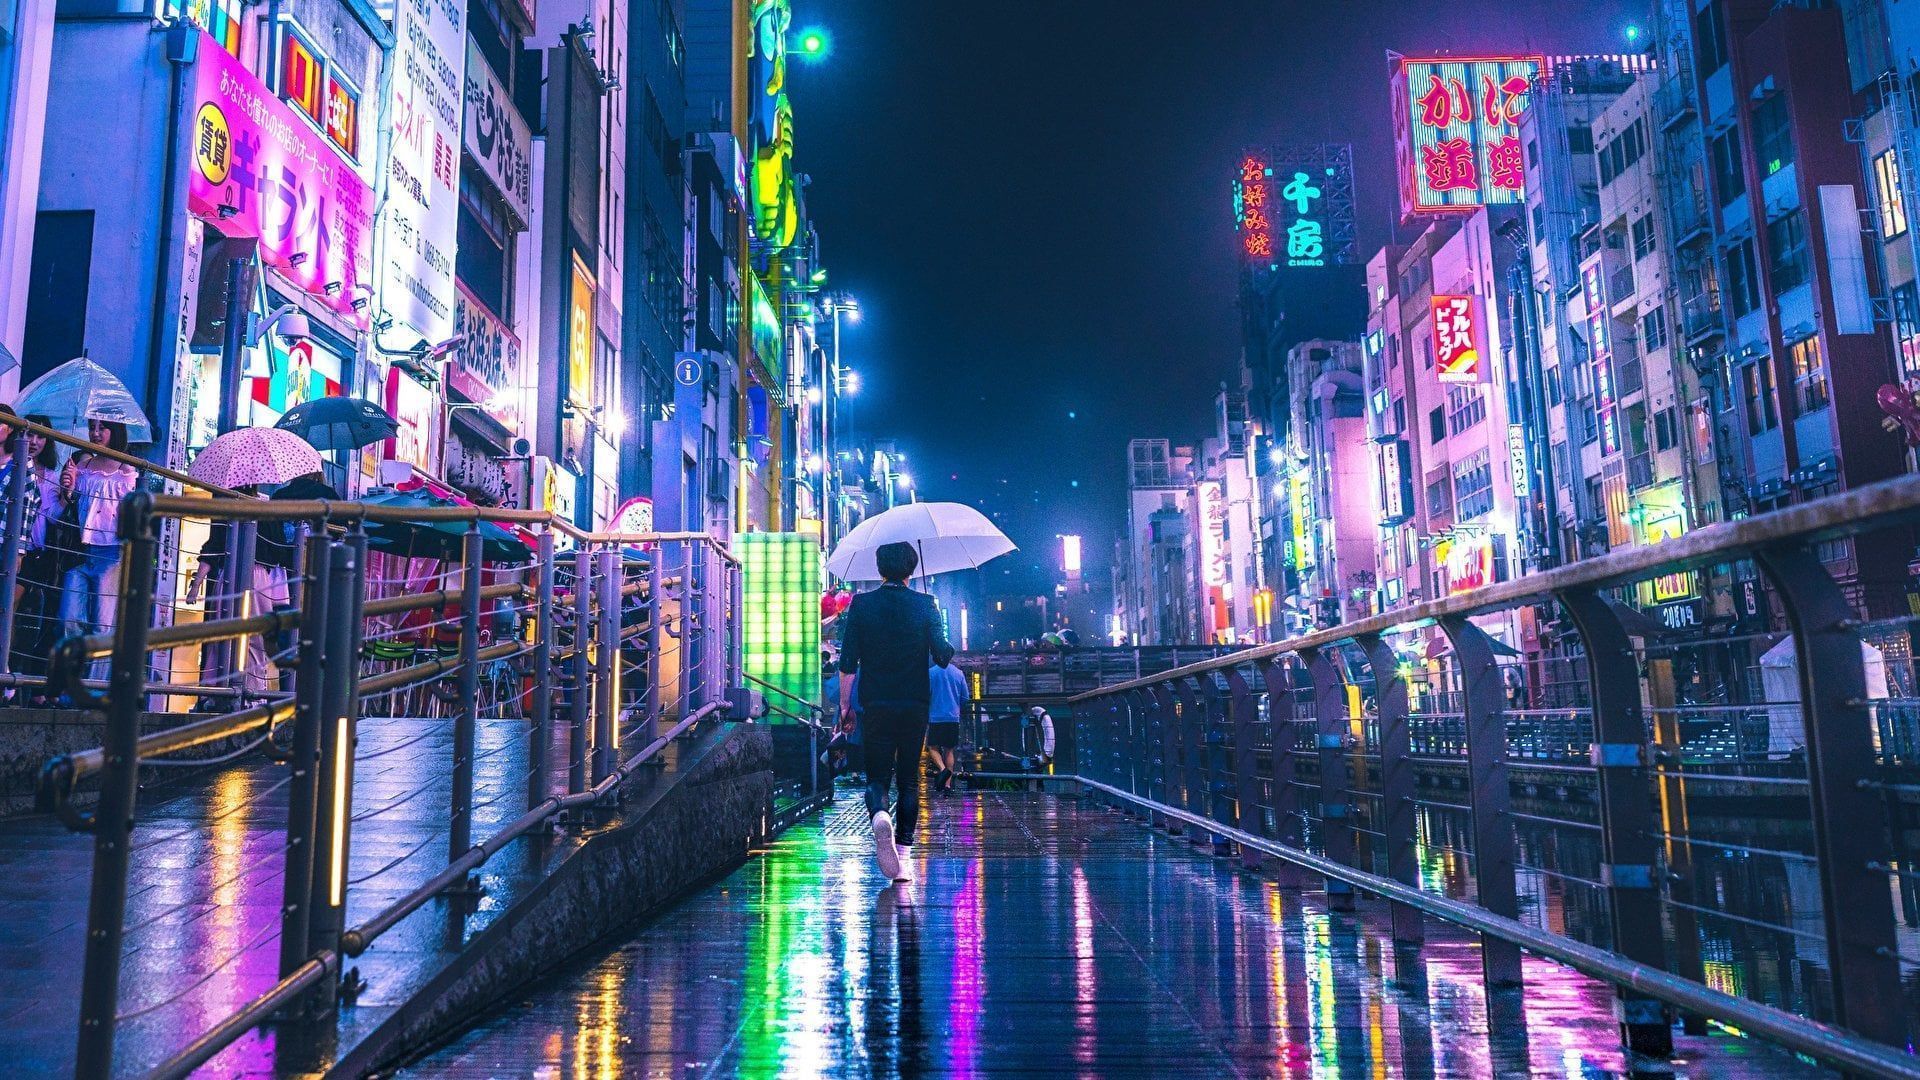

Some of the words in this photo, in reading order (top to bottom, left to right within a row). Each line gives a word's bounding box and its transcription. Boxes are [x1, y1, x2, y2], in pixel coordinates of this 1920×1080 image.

[1417, 74, 1530, 130] かに
[199, 116, 228, 173] 賃貸
[1243, 158, 1270, 256] お好み焼
[1283, 172, 1323, 258] 千房
